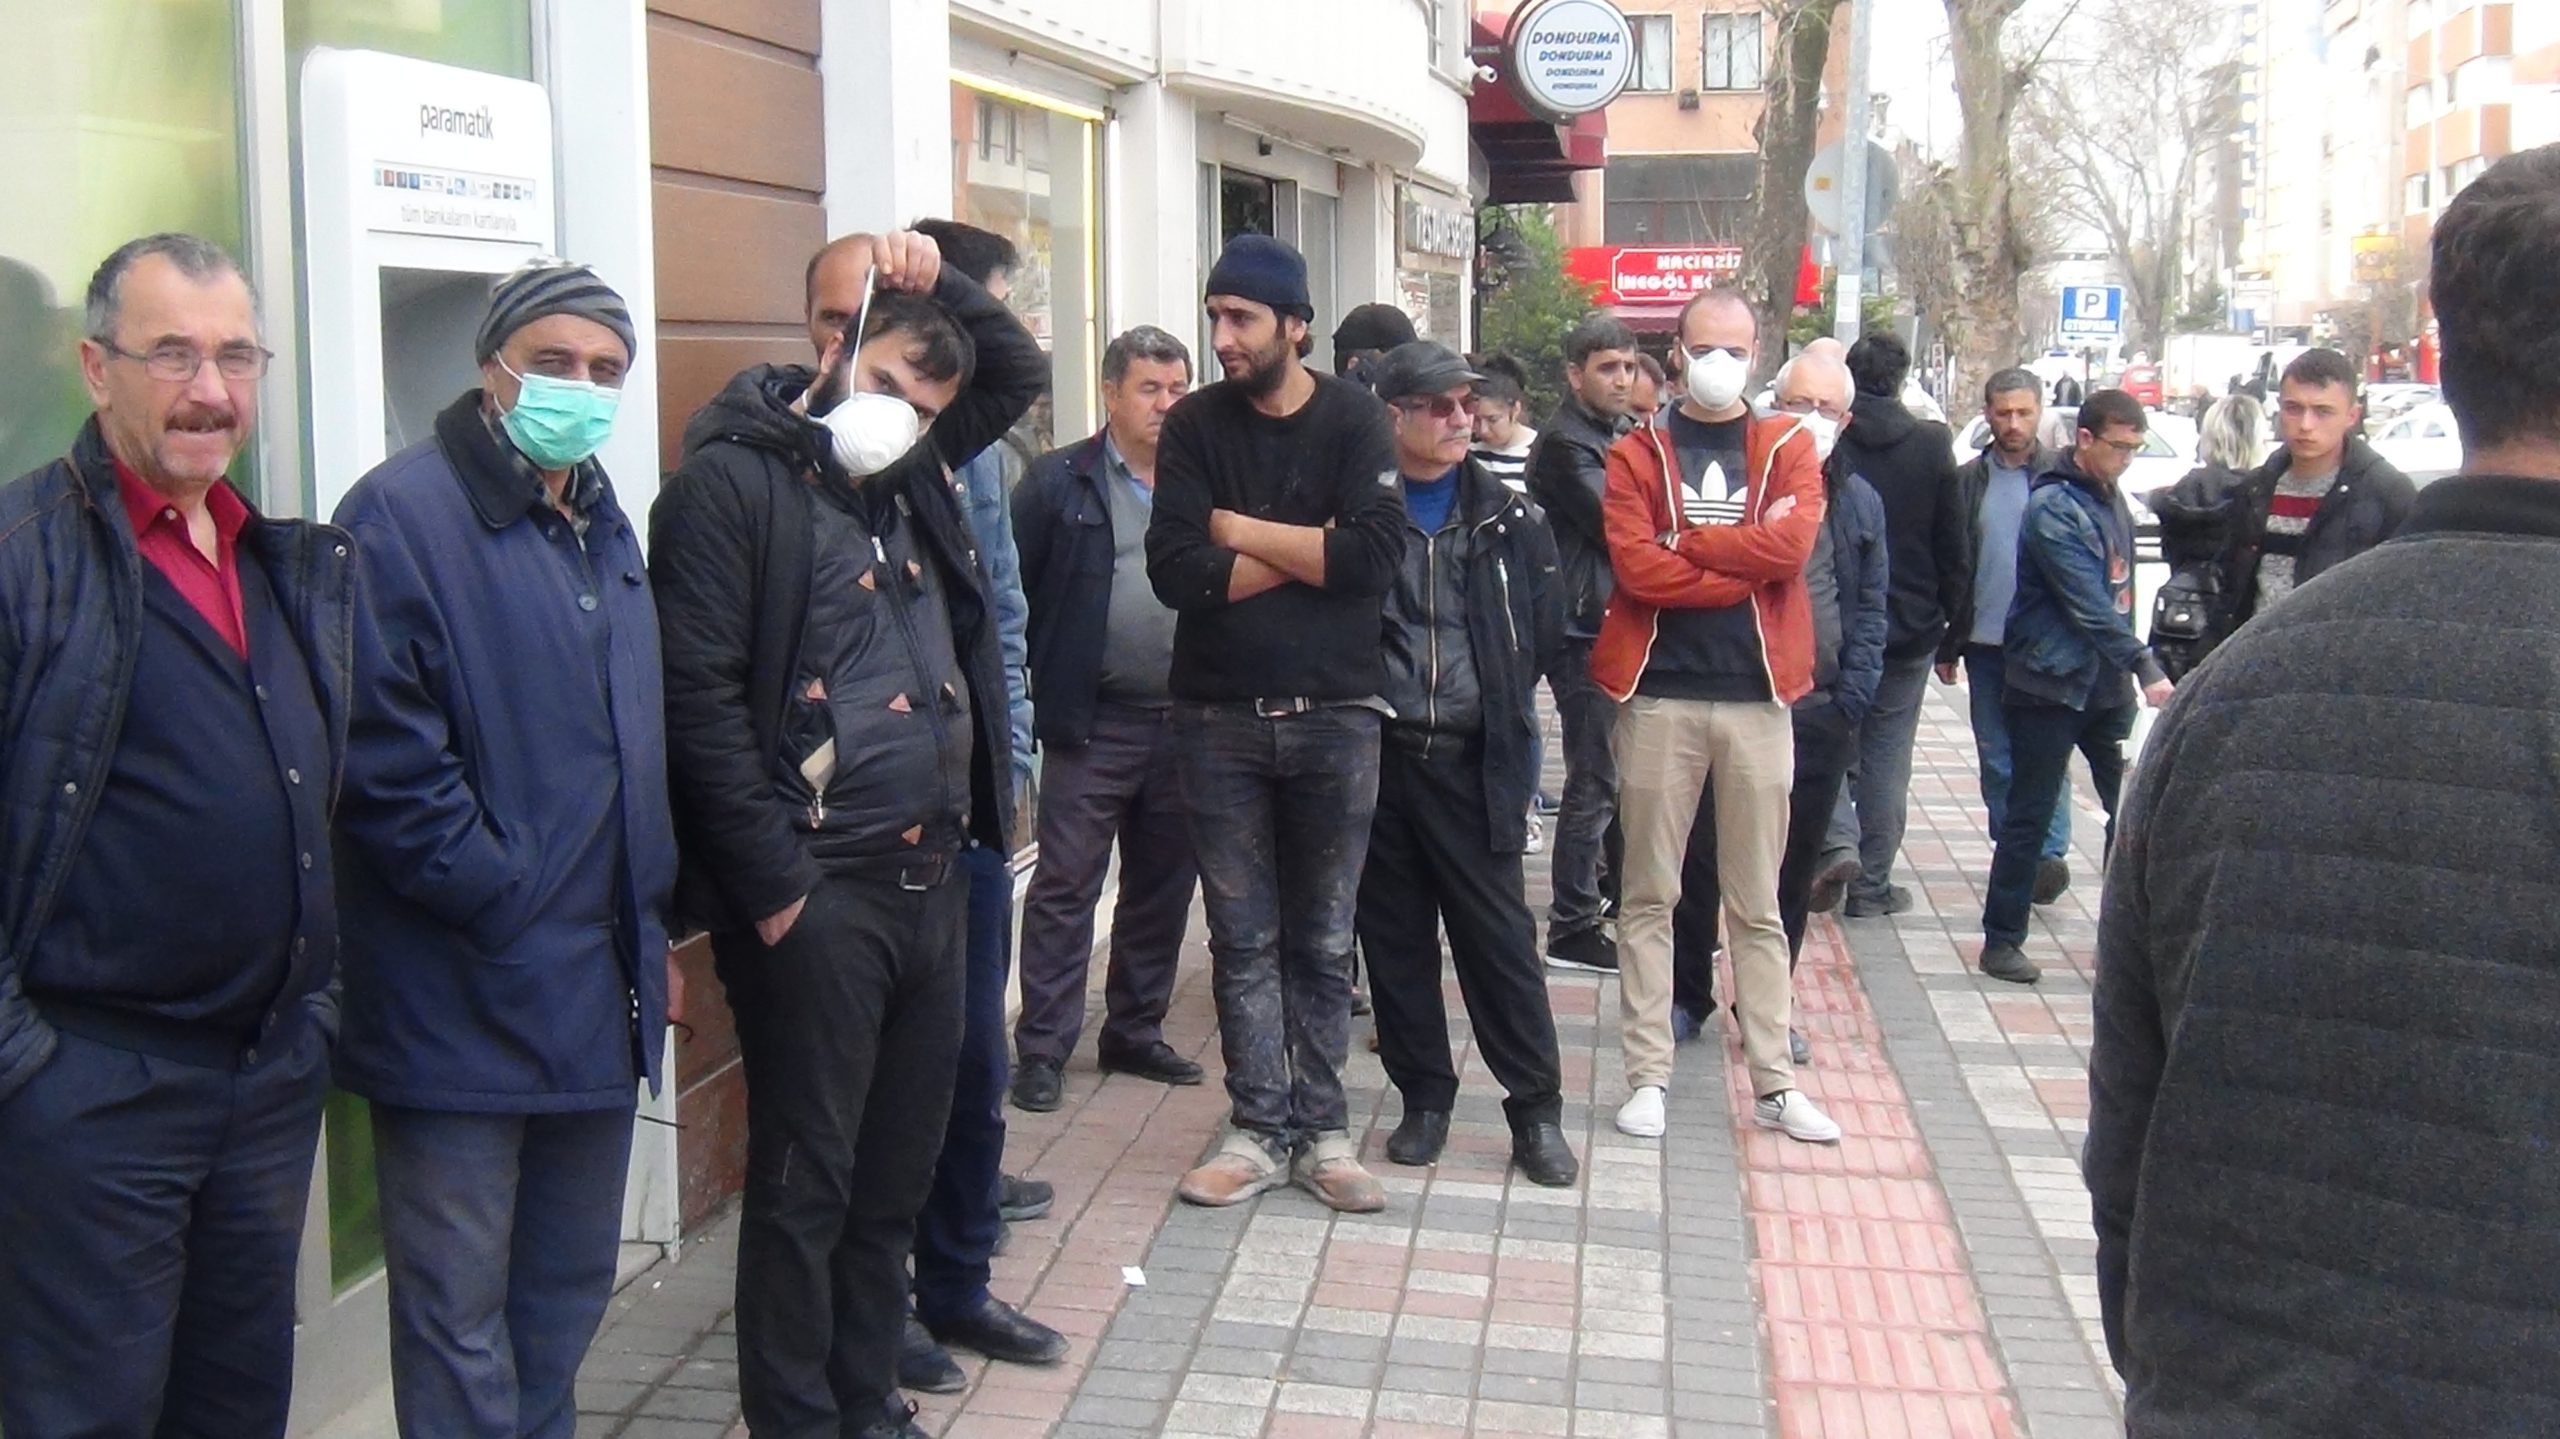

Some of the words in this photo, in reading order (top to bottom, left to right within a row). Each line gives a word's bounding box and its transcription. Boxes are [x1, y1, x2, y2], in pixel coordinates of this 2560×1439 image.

[1532, 31, 1620, 45] DONDURMA
[1539, 50, 1613, 62] DONDURMA
[1546, 67, 1605, 78] DONDURMA
[420, 103, 495, 140] paramatik
[401, 203, 421, 223] tüm
[1617, 271, 1687, 291] İNEGÖL
[2084, 293, 2100, 313] P
